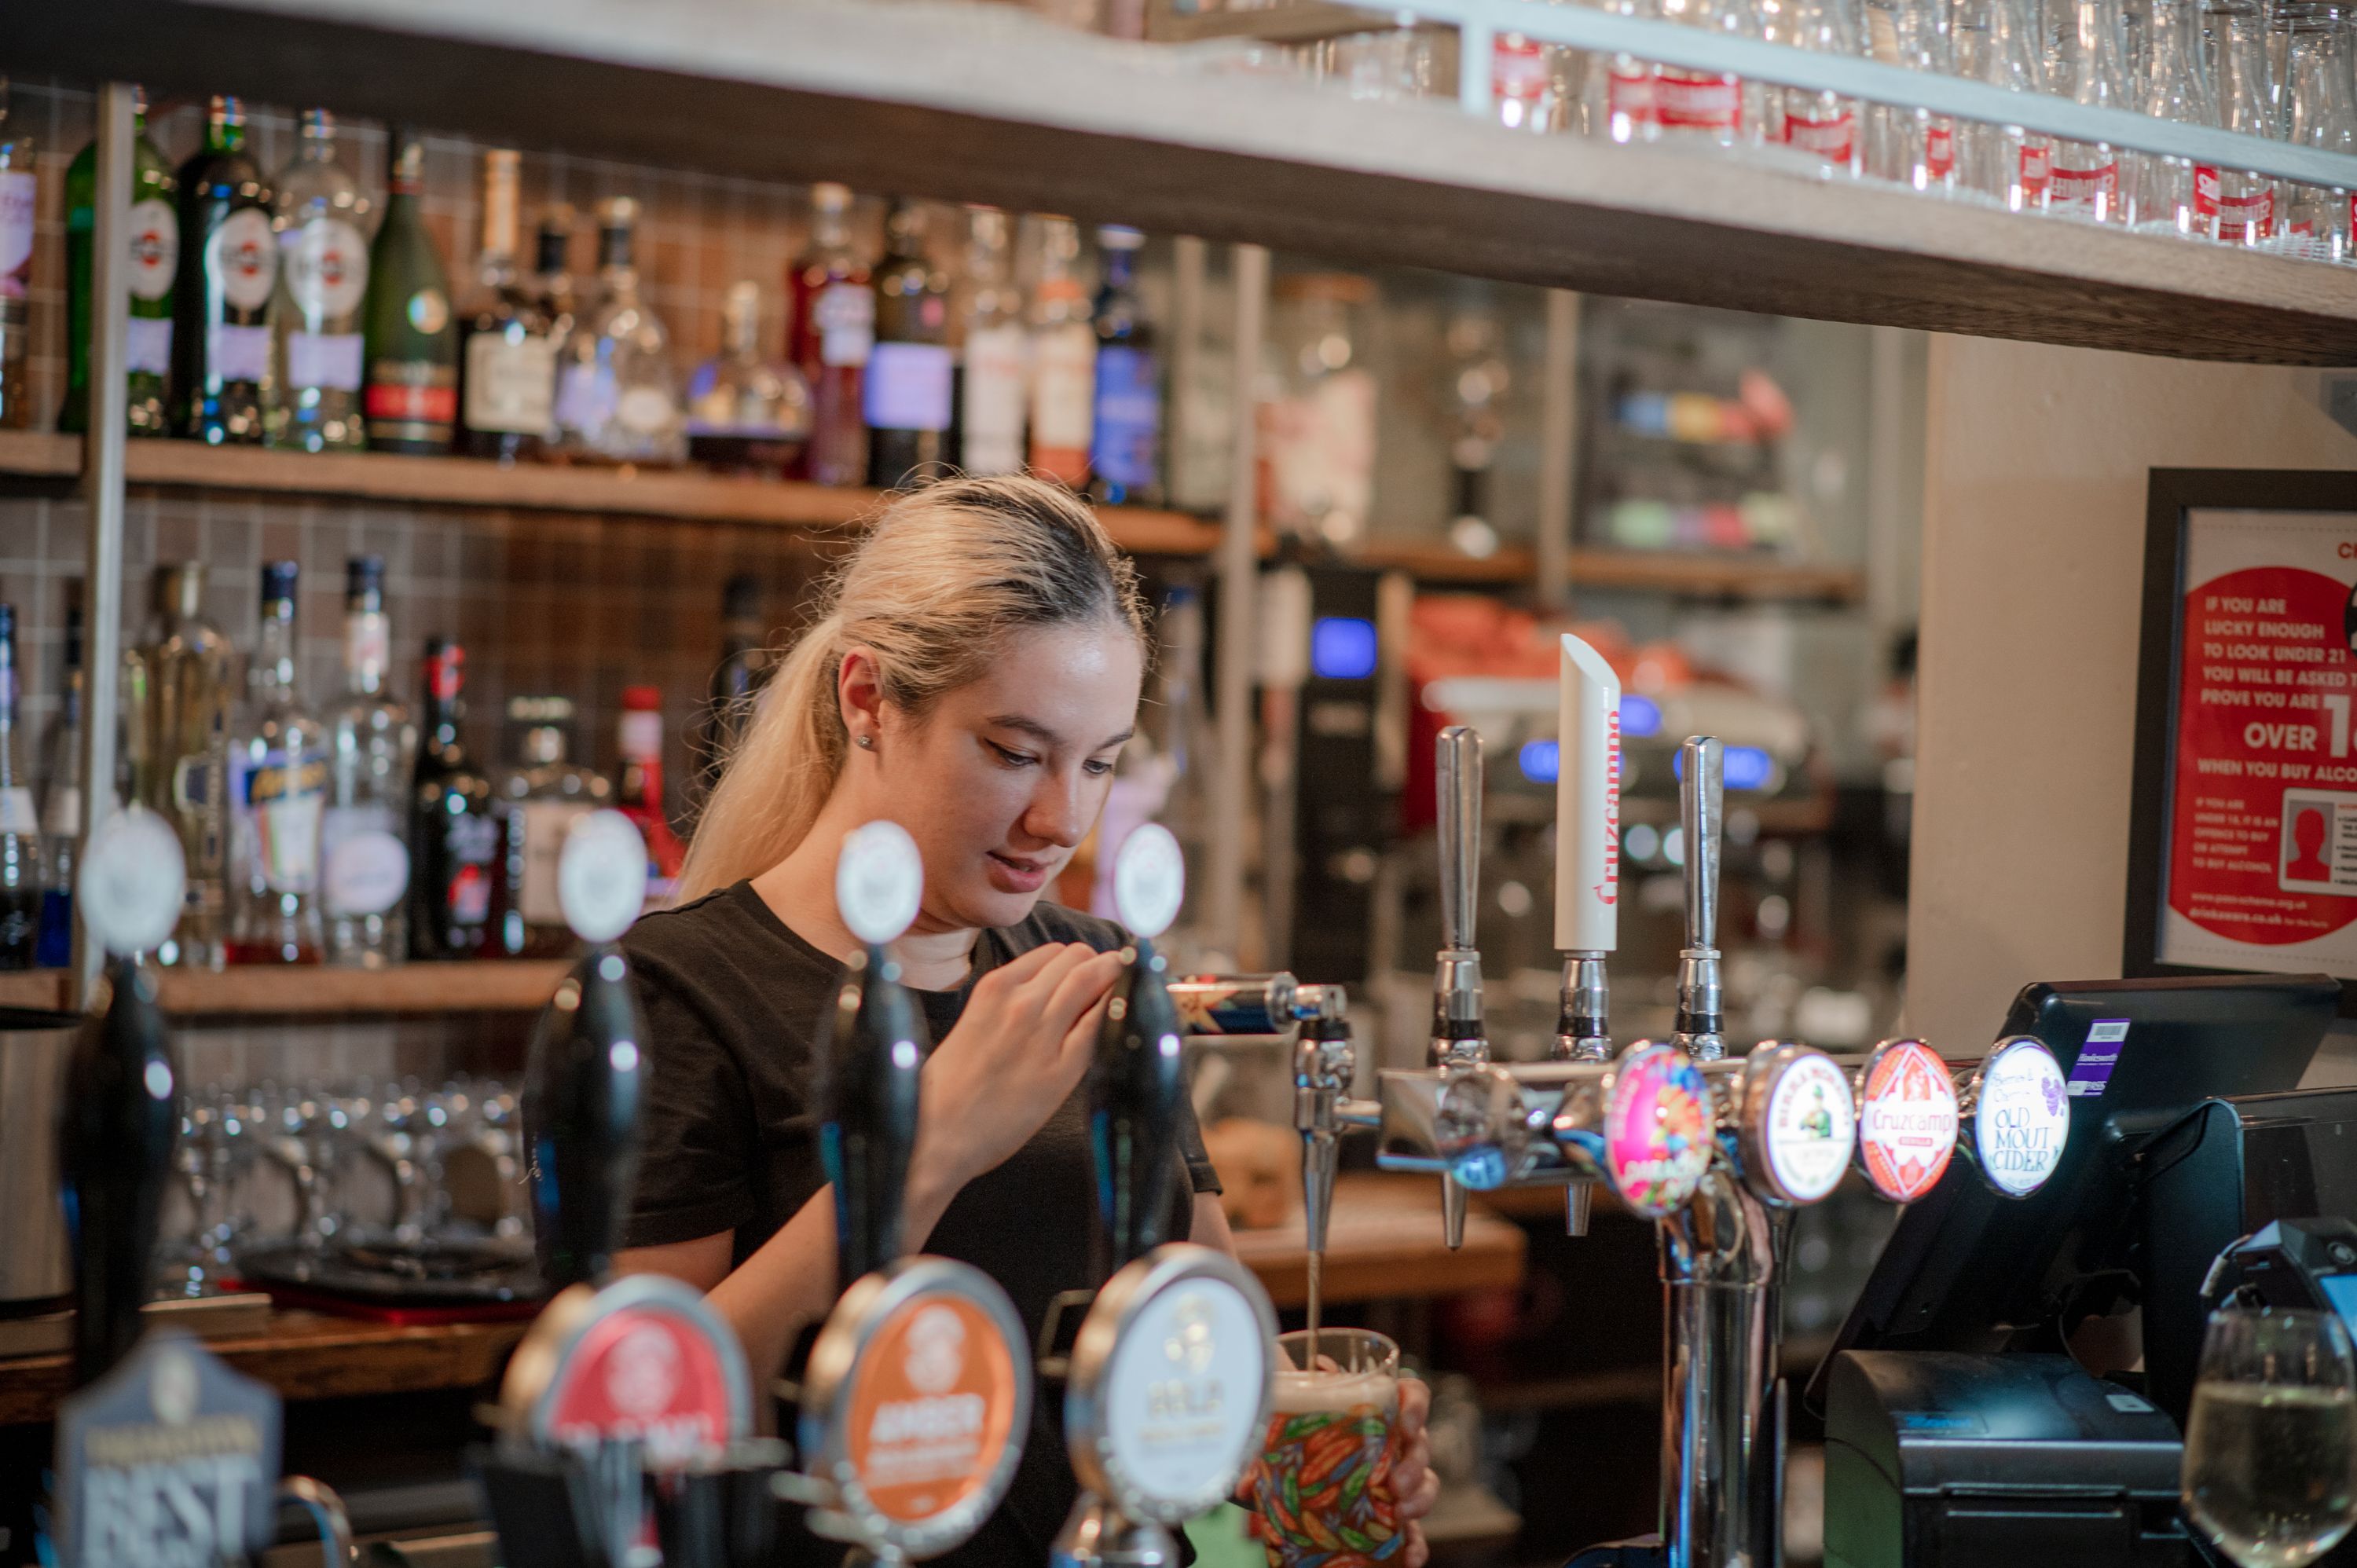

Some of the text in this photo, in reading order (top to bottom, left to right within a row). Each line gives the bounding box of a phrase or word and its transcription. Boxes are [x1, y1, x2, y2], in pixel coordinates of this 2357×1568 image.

[2205, 596, 2286, 614] IF YOU ARE
[2205, 621, 2325, 639] LUCKY ENOUGH
[2204, 643, 2346, 663] TO LOOK UNDER 21
[2203, 666, 2234, 681] YOU
[2238, 668, 2271, 683] WILL
[2275, 669, 2294, 684] BE
[2297, 671, 2347, 687] ASKED
[2201, 689, 2319, 709] PROVE YOU ARE
[2244, 694, 2357, 758] OVER 1
[2198, 758, 2242, 775] WHEN
[2245, 761, 2277, 777] YOU
[2281, 763, 2311, 779] BUY
[1593, 710, 1621, 906] Cruzcampo
[1872, 1108, 1956, 1137] Cruzcamp
[1995, 1107, 2030, 1129] OLD
[1996, 1127, 2053, 1150] MOUT
[1993, 1149, 2048, 1171] CIDER
